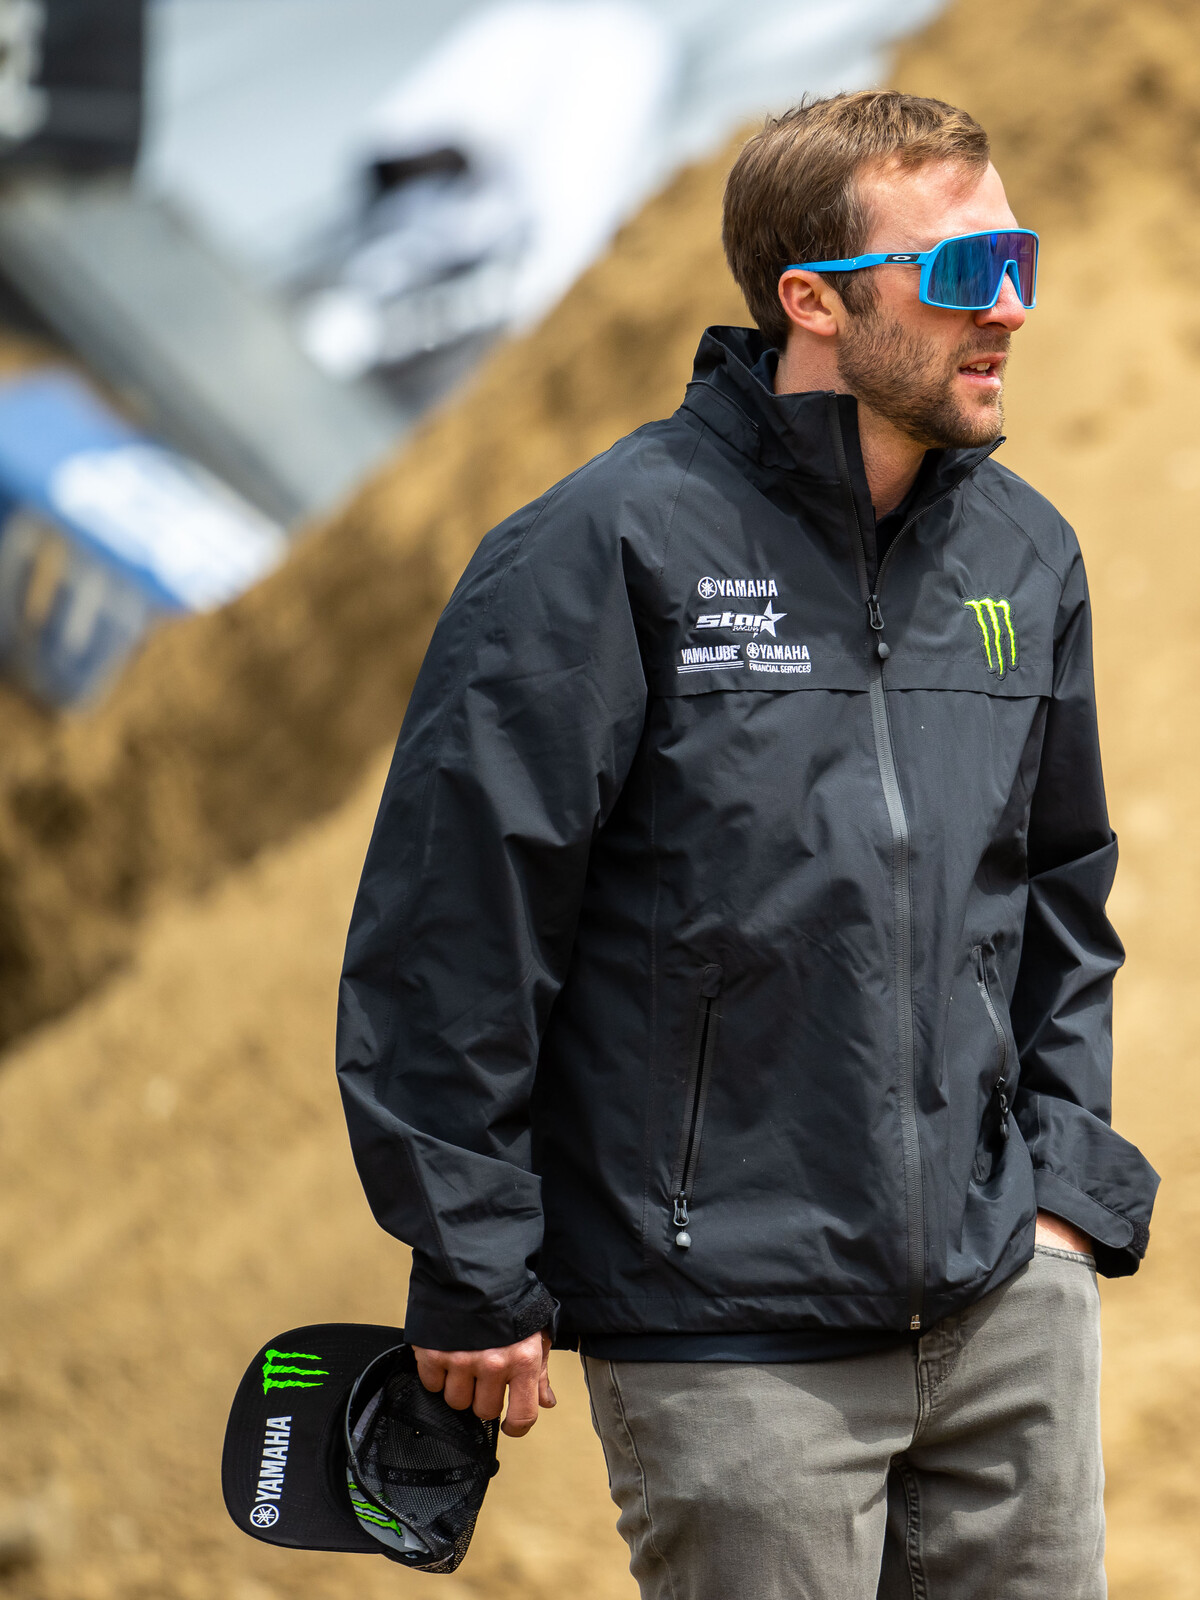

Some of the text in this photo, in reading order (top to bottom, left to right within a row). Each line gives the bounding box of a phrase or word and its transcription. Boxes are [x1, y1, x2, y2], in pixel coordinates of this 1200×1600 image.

[717, 579, 778, 597] YAMAHA
[681, 645, 741, 664] YAMALUBE
[759, 645, 810, 660] YAMAHA
[749, 662, 812, 674] FINANCIAL SERVICES
[254, 1415, 292, 1503] YAMAHA
